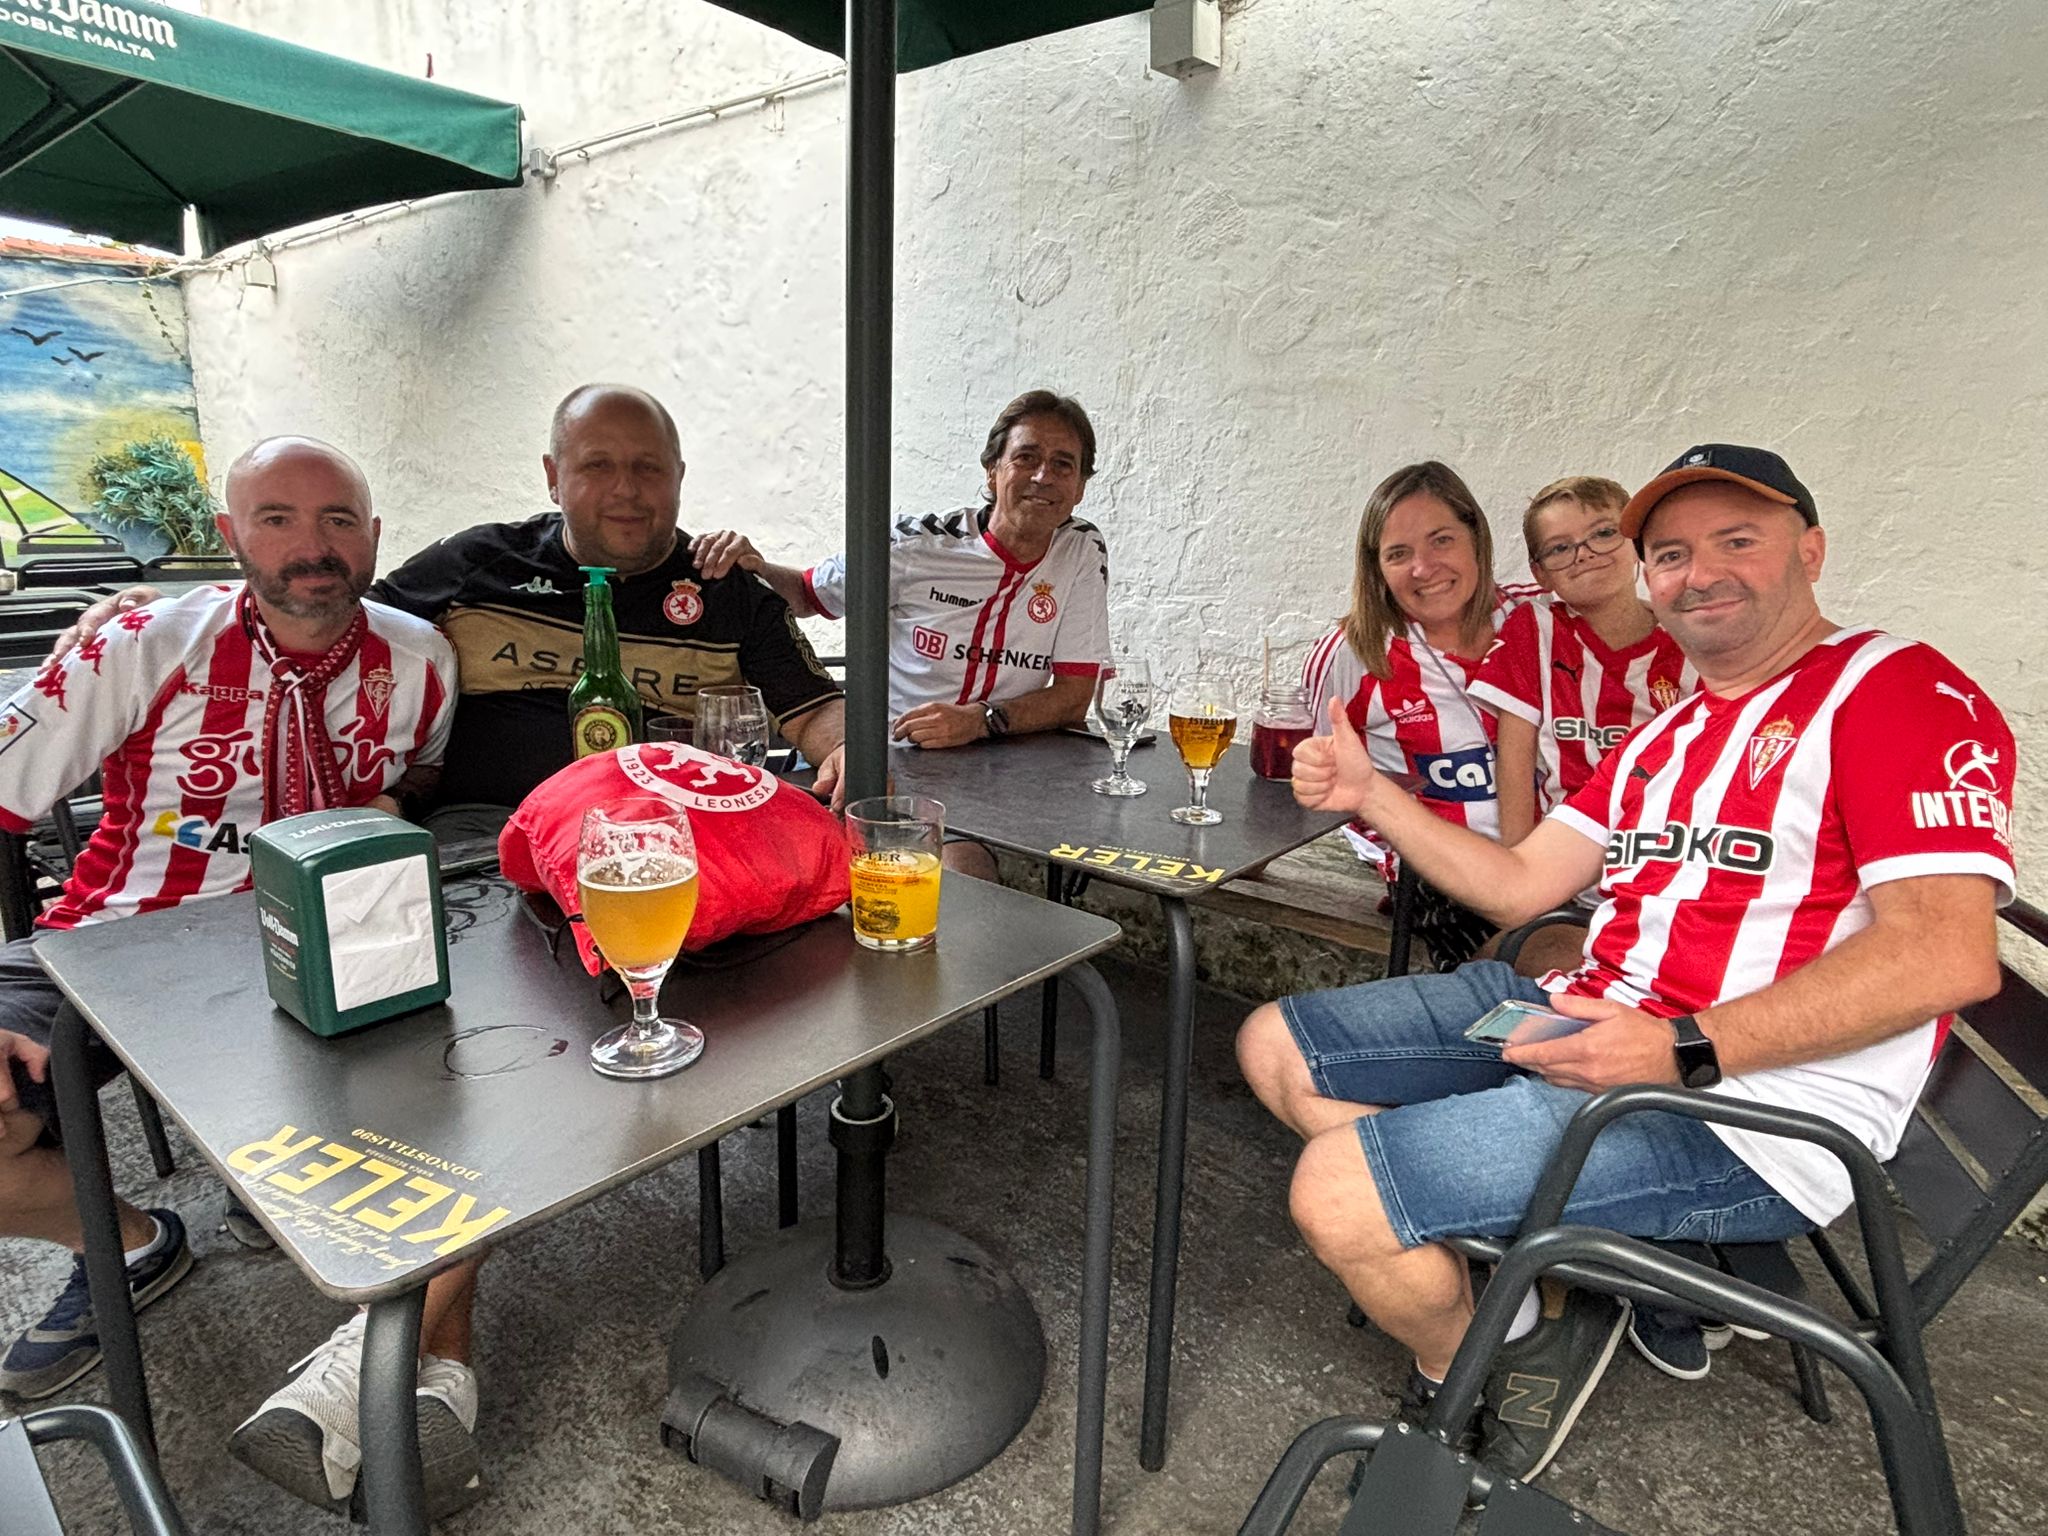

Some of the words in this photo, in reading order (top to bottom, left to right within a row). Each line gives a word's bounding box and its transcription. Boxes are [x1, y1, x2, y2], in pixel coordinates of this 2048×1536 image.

[83, 30, 156, 61] MALTA
[929, 586, 983, 608] humme
[915, 629, 944, 655] DB
[953, 644, 1051, 671] SCHENKER
[491, 641, 700, 699] ASPRE
[181, 681, 264, 702] Kappa
[1400, 713, 1435, 724] adidas
[622, 757, 655, 785] 1923
[694, 785, 773, 809] LEONESA
[1050, 843, 1226, 883] KELER
[351, 1128, 391, 1146] 1890
[387, 1140, 483, 1181] DONOSTIA
[227, 1124, 512, 1257] KELER
[1498, 1372, 1561, 1430] N
